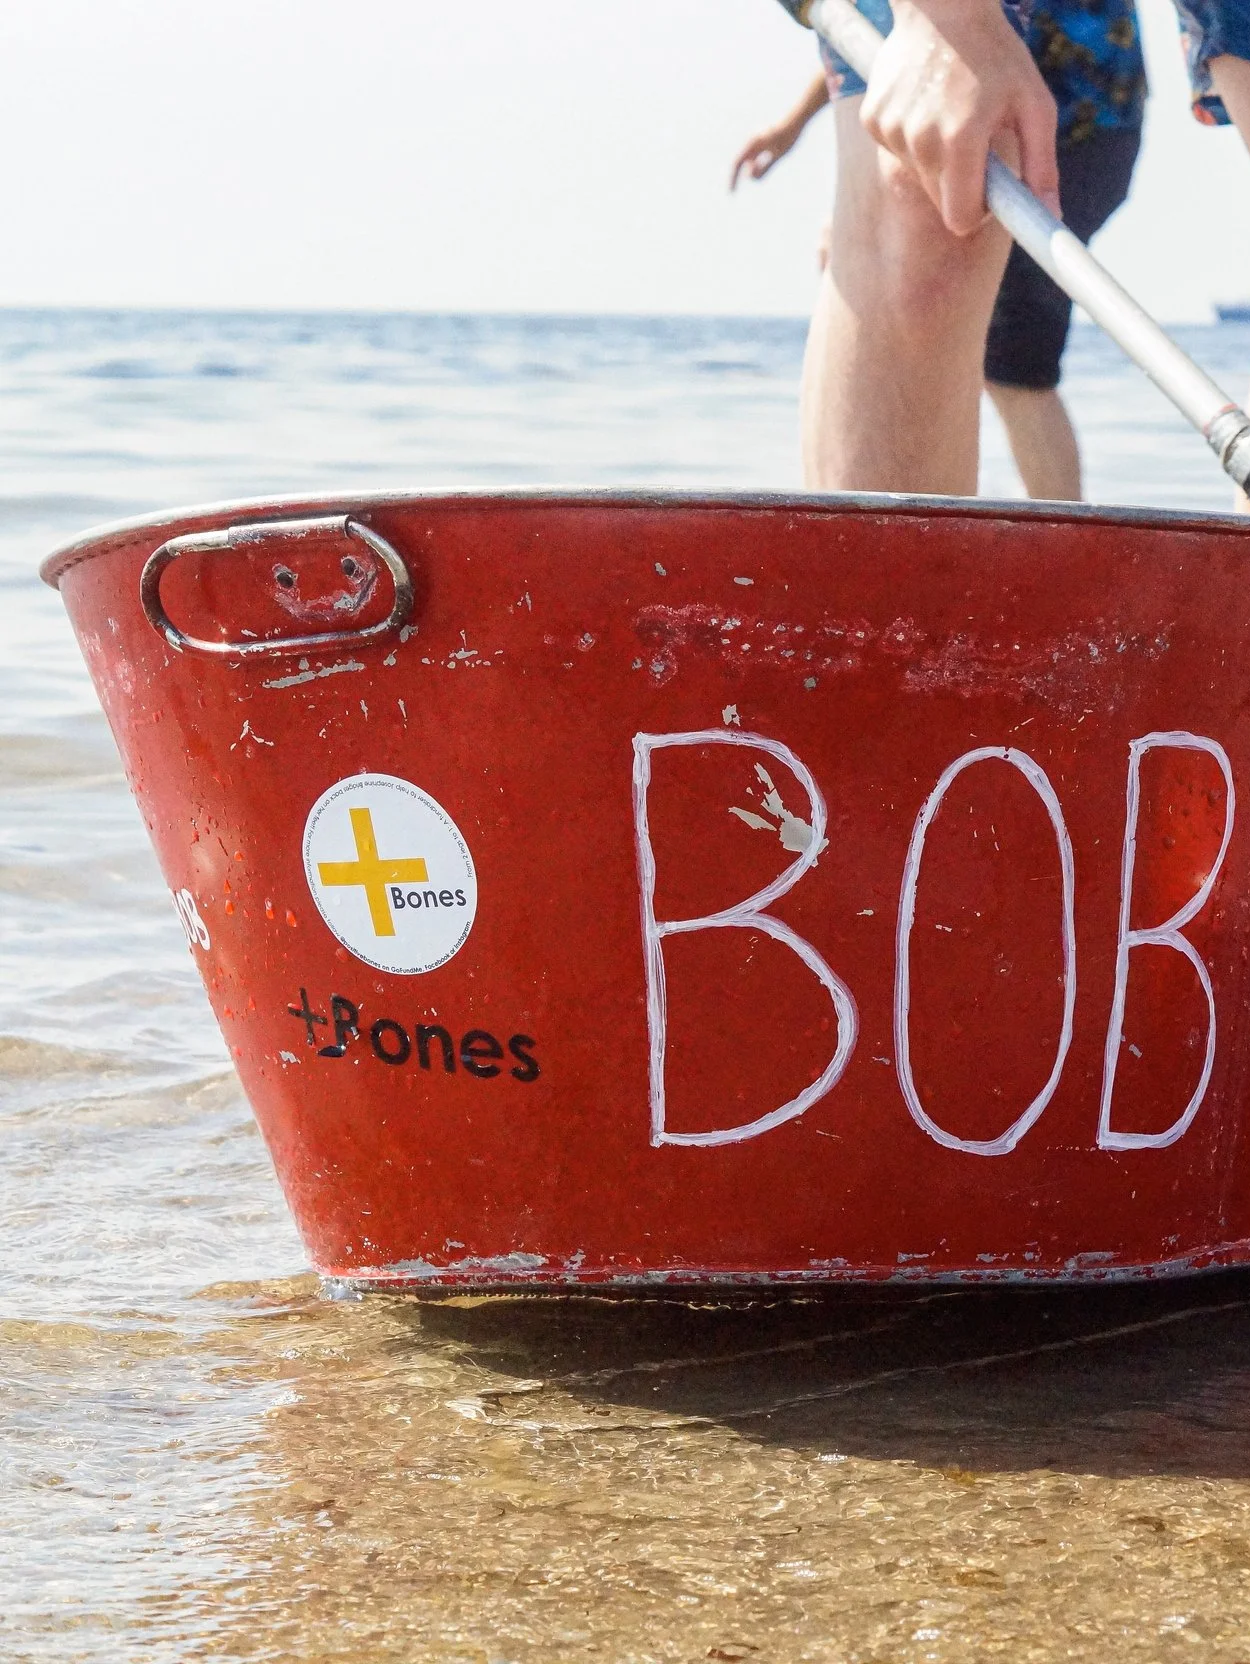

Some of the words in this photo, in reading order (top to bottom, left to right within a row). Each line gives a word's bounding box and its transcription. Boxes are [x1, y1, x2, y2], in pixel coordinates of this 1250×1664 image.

[364, 780, 394, 789] Josephine
[395, 784, 409, 795] help
[330, 790, 344, 801] back
[323, 799, 330, 807] on
[417, 796, 444, 820] fundraiser
[316, 805, 325, 815] her
[452, 832, 459, 840] to
[306, 858, 317, 895] information
[390, 886, 468, 910] Bones
[633, 727, 1236, 1157] BOB
[450, 947, 456, 955] or
[424, 953, 450, 970] Facebook
